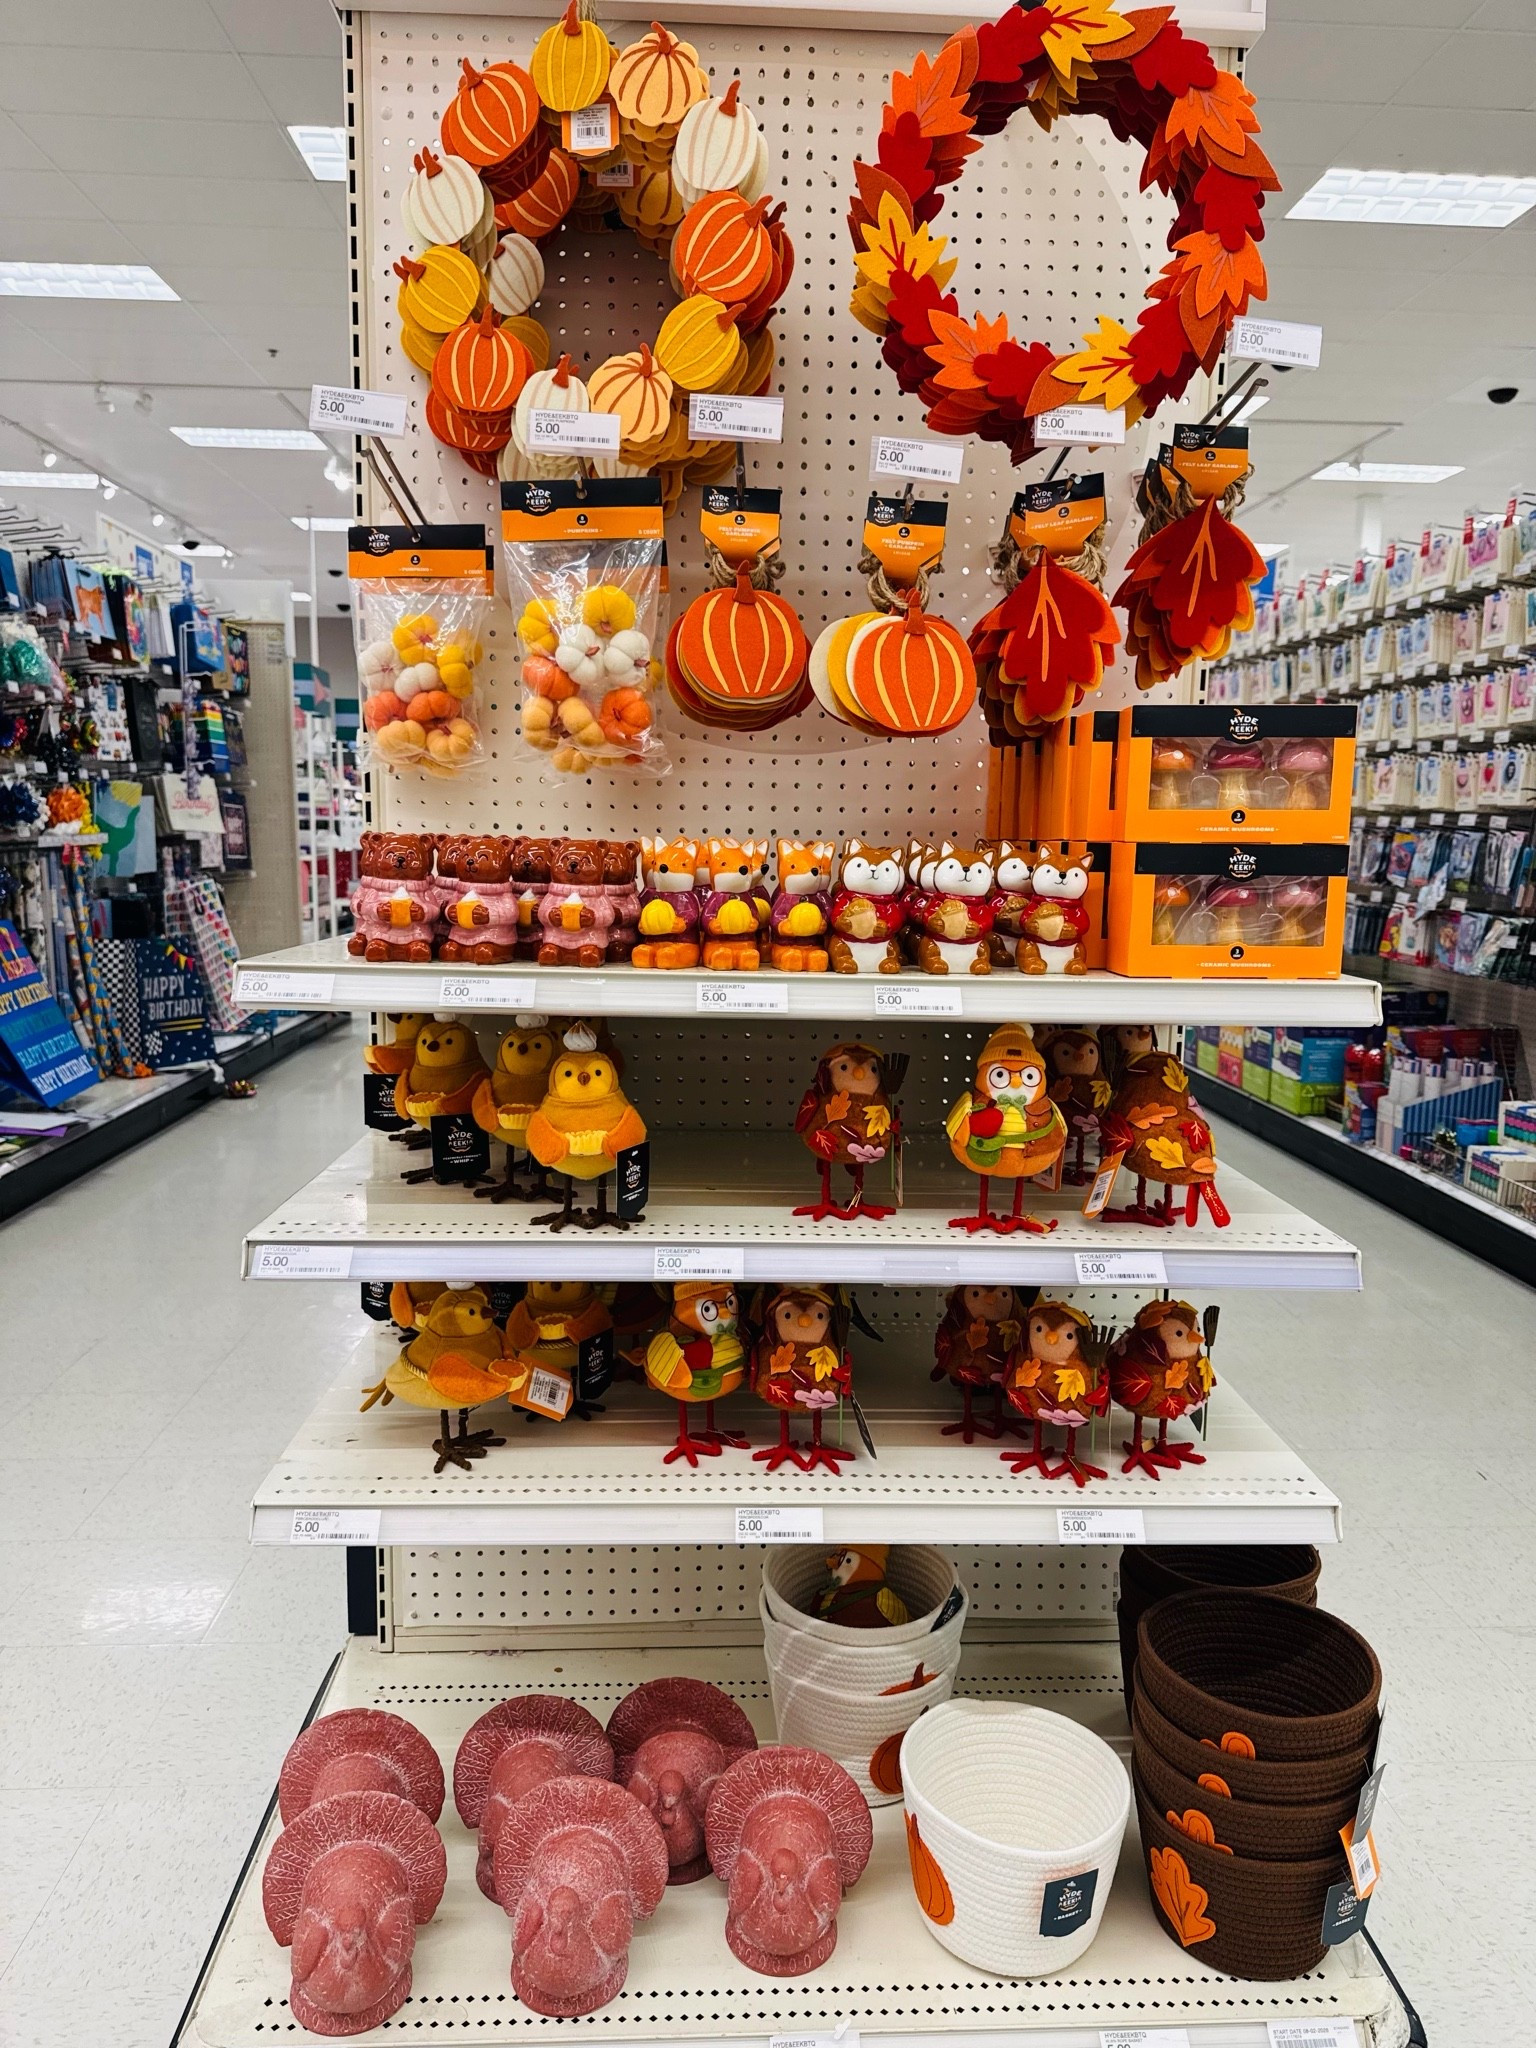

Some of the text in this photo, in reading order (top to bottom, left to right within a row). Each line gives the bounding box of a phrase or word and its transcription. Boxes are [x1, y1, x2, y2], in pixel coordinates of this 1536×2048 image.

[1241, 322, 1281, 334] HYDE&EEKBTQ
[1240, 332, 1263, 346] 5.00
[321, 389, 365, 401] HYDE&EEKBTQ
[319, 399, 345, 413] 5.00
[699, 398, 742, 409] HYDE&EEKBTQ
[535, 412, 579, 420] HYDE&EEKBTQ
[698, 409, 723, 422] 5.00
[535, 422, 560, 434] 5.00
[1040, 417, 1064, 429] 5.00
[1180, 432, 1200, 440] HYDE
[880, 439, 924, 451] HYDE&EEKBTQ
[879, 449, 904, 463] 5.00
[525, 488, 551, 498] HYDE
[708, 494, 730, 502] HYDE
[1031, 491, 1053, 500] HYDE
[874, 506, 896, 514] HYDE
[368, 534, 391, 542] HYDE
[1230, 716, 1260, 725] HYDE
[1229, 854, 1258, 864] HYDE
[142, 974, 186, 1000] HAPPY
[241, 982, 268, 992] 5.00
[443, 986, 470, 996] 5.00
[702, 992, 727, 1002] 5.00
[877, 995, 902, 1005] 5.00
[148, 998, 204, 1020] BIRTHDAY
[17, 1042, 46, 1070] HAPPY
[32, 1069, 62, 1096] HAPPY
[448, 1132, 473, 1140] HYDE
[626, 1165, 641, 1176] HYDE
[262, 1256, 288, 1266] 5.00
[657, 1258, 682, 1268] 5.00
[1081, 1263, 1106, 1274] 5.00
[294, 1521, 320, 1533] 5.00
[738, 1520, 763, 1531] 5.00
[1063, 1520, 1087, 1532] 5.00
[1059, 1890, 1083, 1902] HYDE
[1057, 1910, 1079, 1920] BASKET
[772, 2040, 816, 2048] HYDE&EEKBTQ
